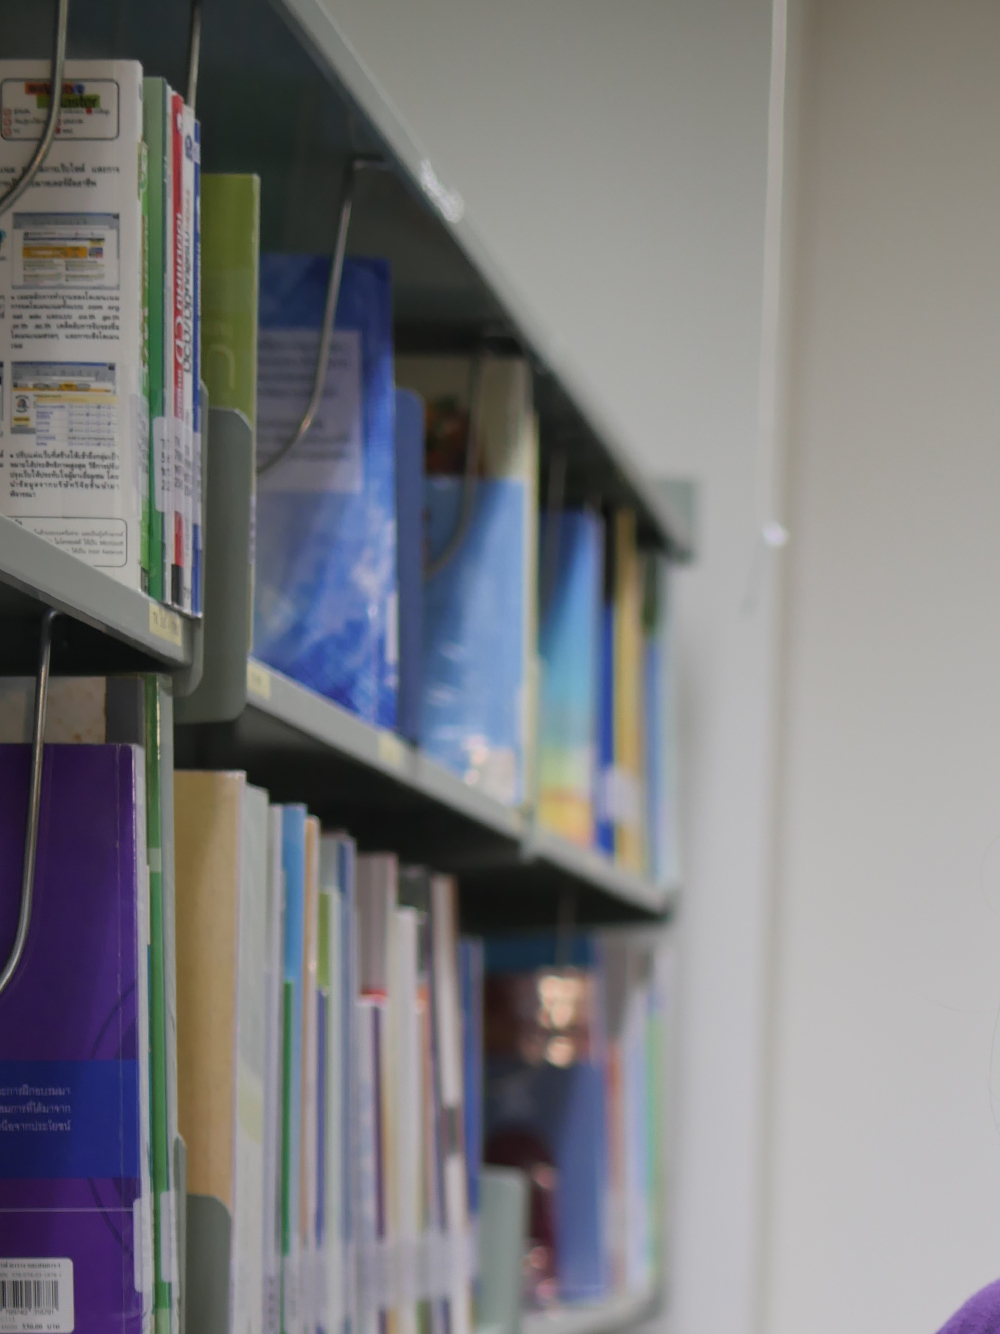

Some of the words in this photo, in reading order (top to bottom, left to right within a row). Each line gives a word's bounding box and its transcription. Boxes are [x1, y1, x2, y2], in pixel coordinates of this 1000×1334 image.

[0, 1118, 71, 1131] นือจากประโยชน์
